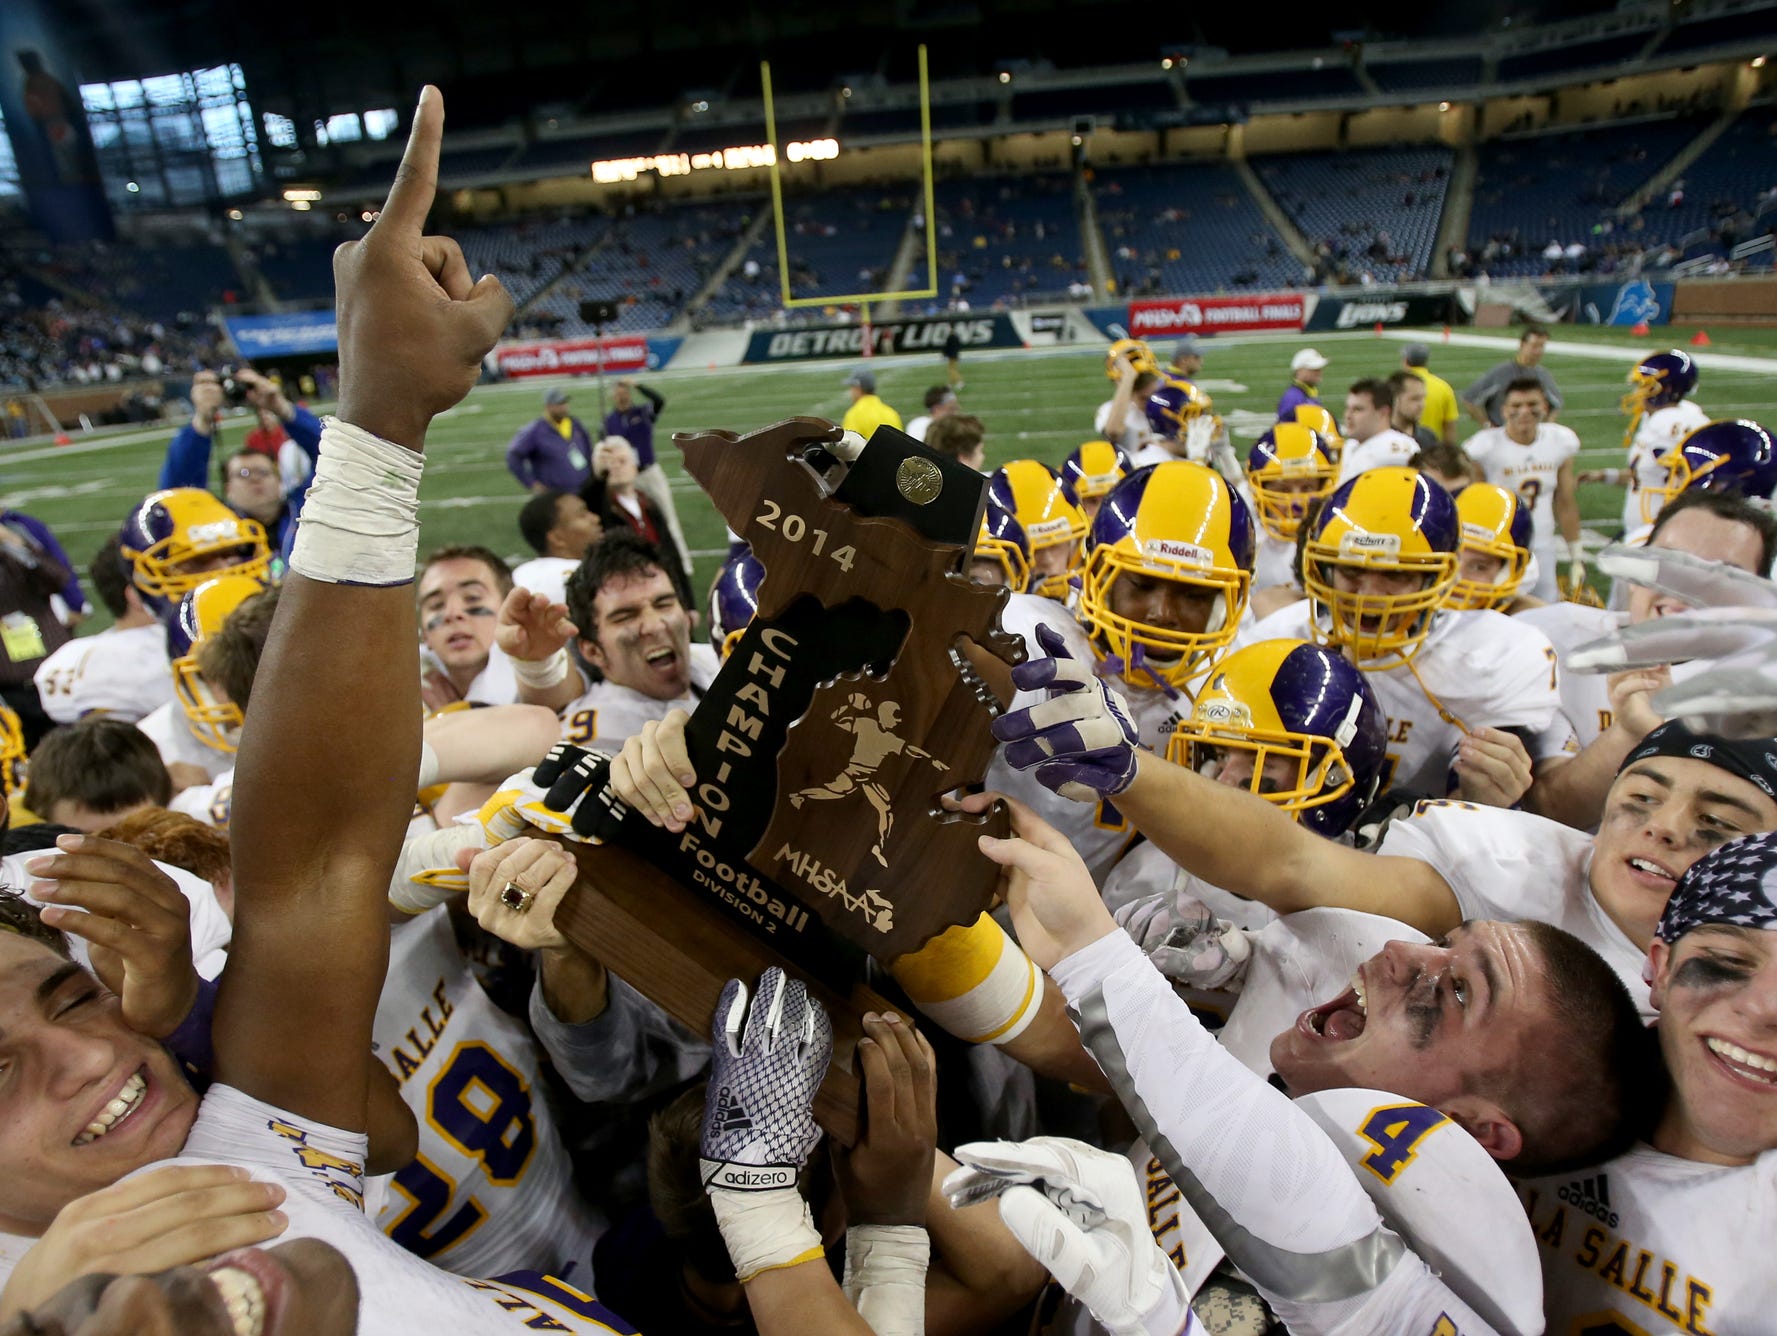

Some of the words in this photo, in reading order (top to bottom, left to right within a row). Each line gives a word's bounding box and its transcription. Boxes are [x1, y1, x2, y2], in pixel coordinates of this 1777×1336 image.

[902, 320, 995, 346] LIONS
[1205, 306, 1258, 323] FOOTBALL
[1262, 303, 1300, 319] FINALS
[755, 499, 857, 573] 2014
[1160, 543, 1198, 559] Riddell
[690, 628, 799, 839] CHAMPION
[679, 832, 809, 933] Football
[692, 869, 765, 925] DIVISION
[765, 921, 777, 934] 2
[773, 842, 877, 924] MHSAA
[710, 1086, 731, 1139] adidas
[1355, 1103, 1453, 1187] 4
[384, 1039, 539, 1259] 28
[725, 1170, 787, 1186] adizero
[1557, 1186, 1620, 1229] adidas
[1575, 1222, 1718, 1336] SALLE
